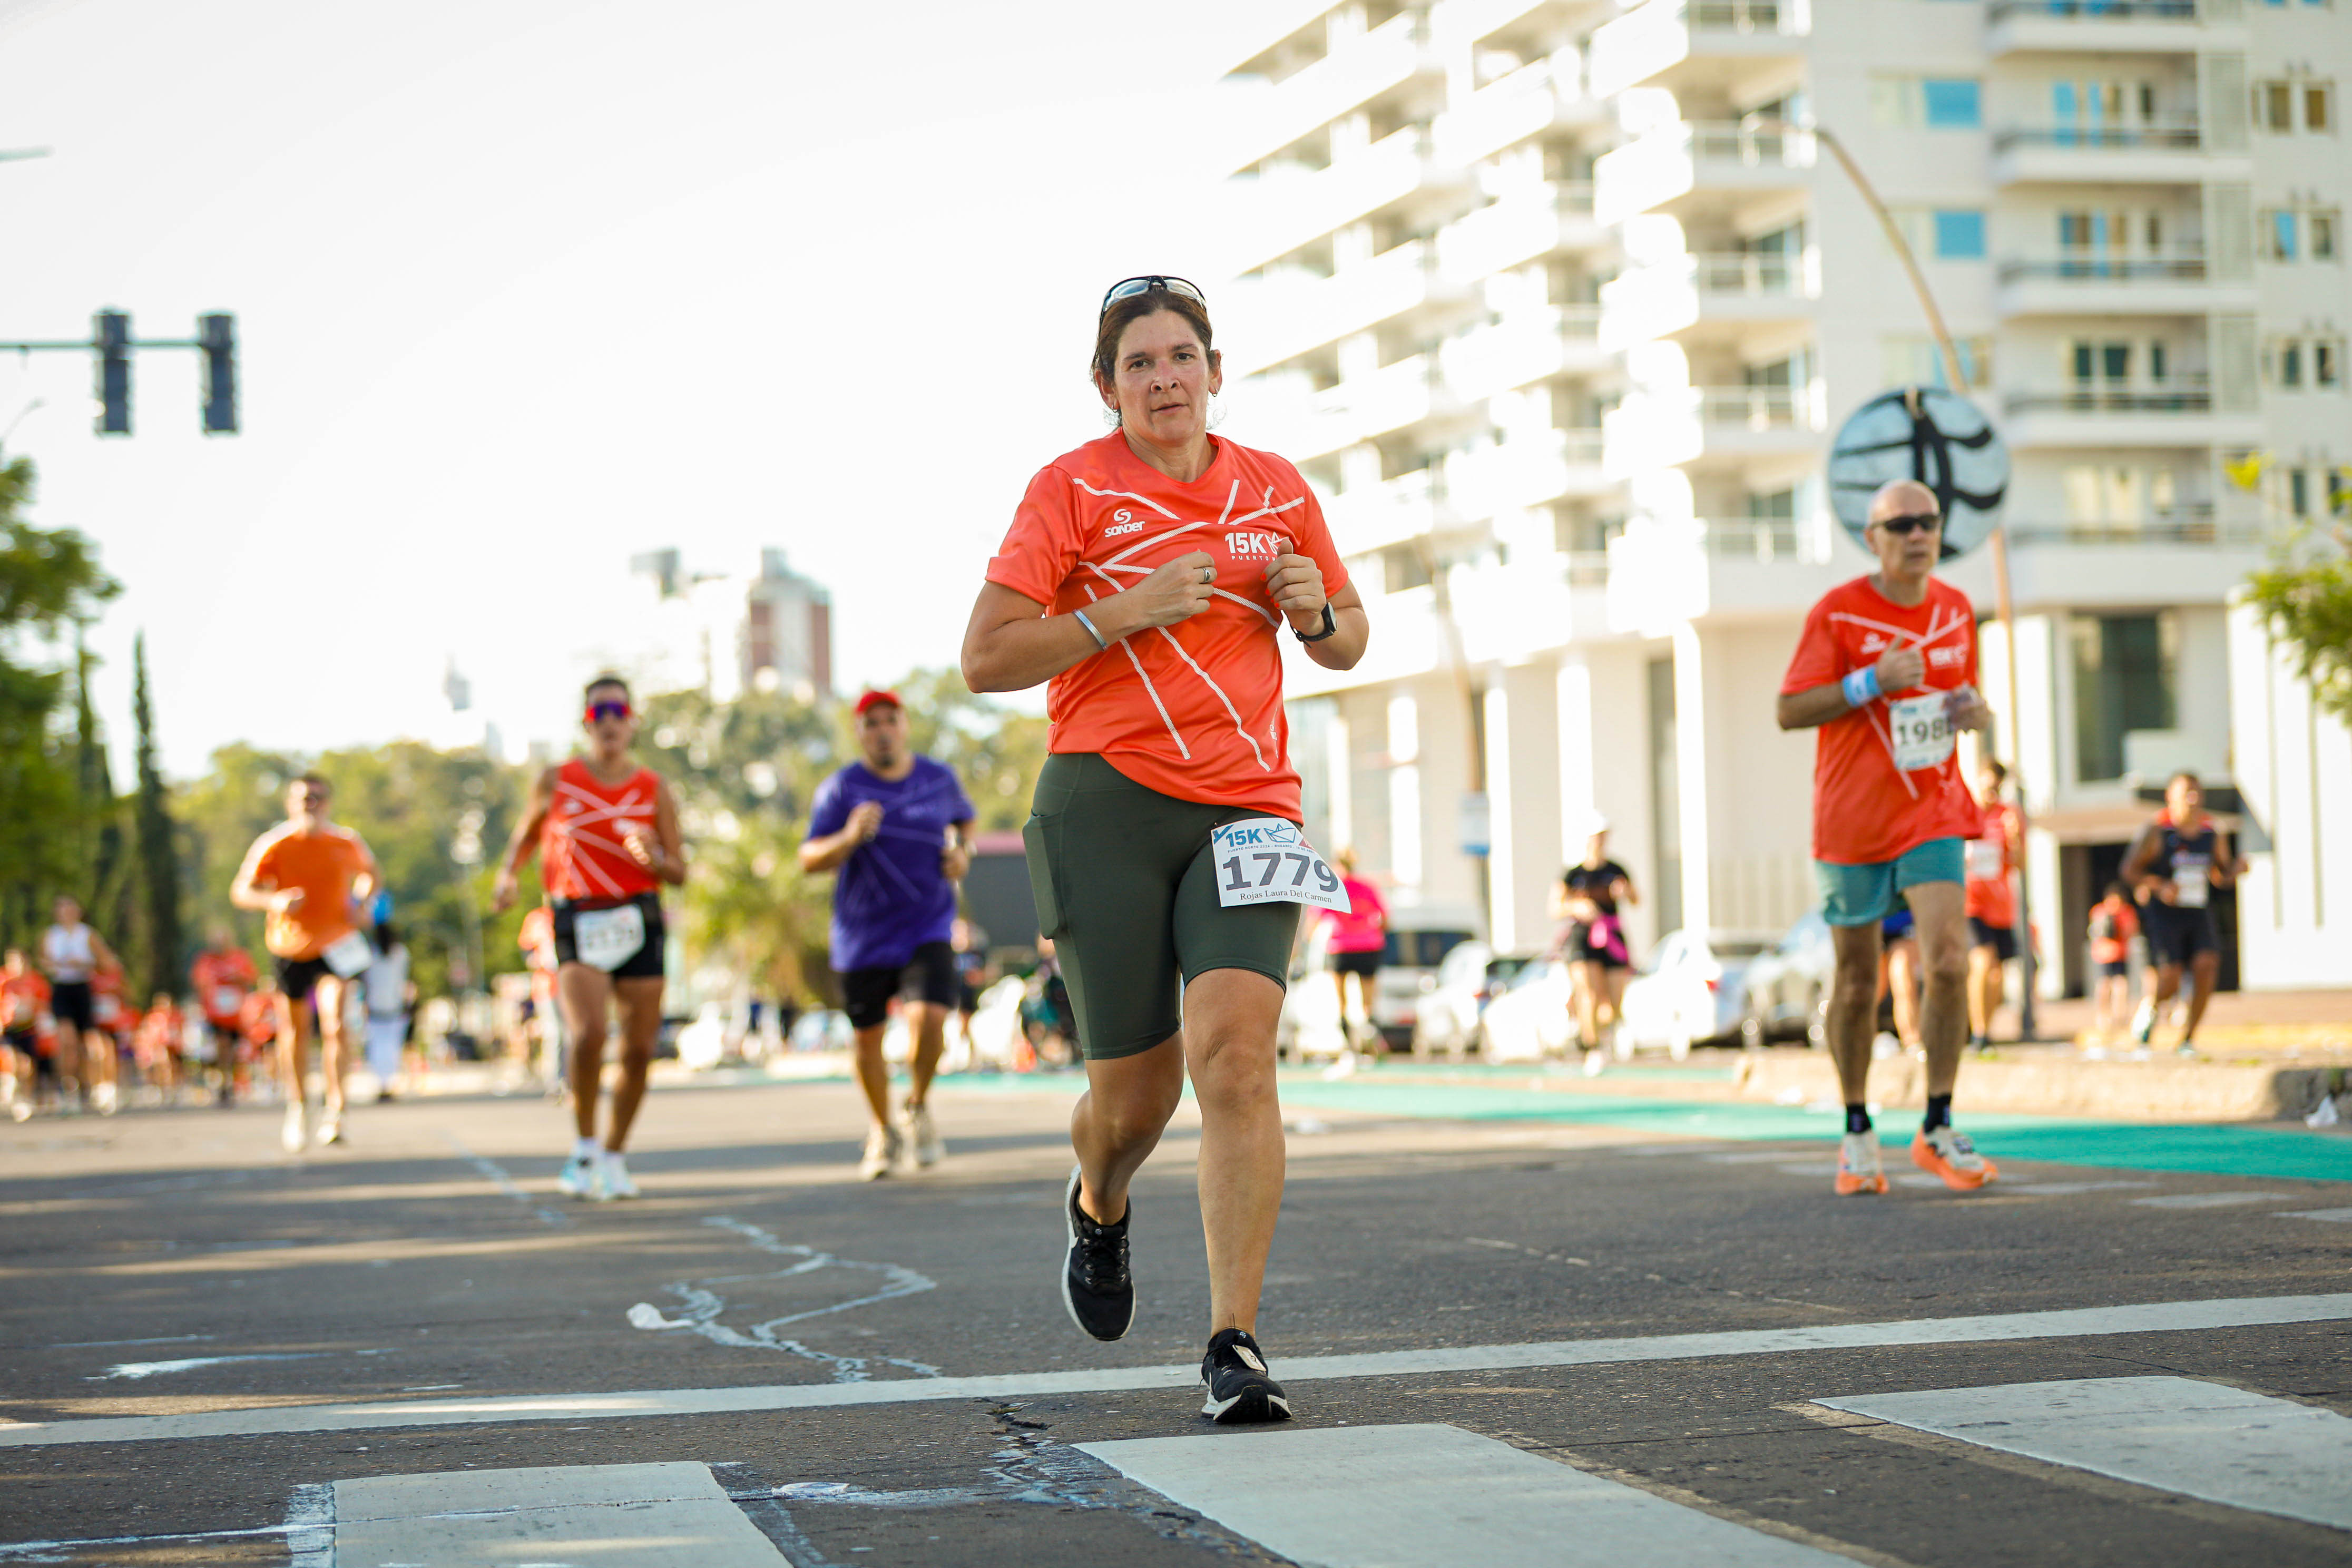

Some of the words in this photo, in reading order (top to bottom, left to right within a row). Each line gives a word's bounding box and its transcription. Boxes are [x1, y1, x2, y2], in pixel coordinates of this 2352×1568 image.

[1225, 532, 1267, 554] 15K
[1897, 718, 1954, 746] 198
[1226, 828, 1263, 847] 15K
[1223, 852, 1338, 892] 1779
[1240, 892, 1262, 900] Rojas
[1290, 889, 1303, 898] Del
[1305, 891, 1332, 903] Carmen
